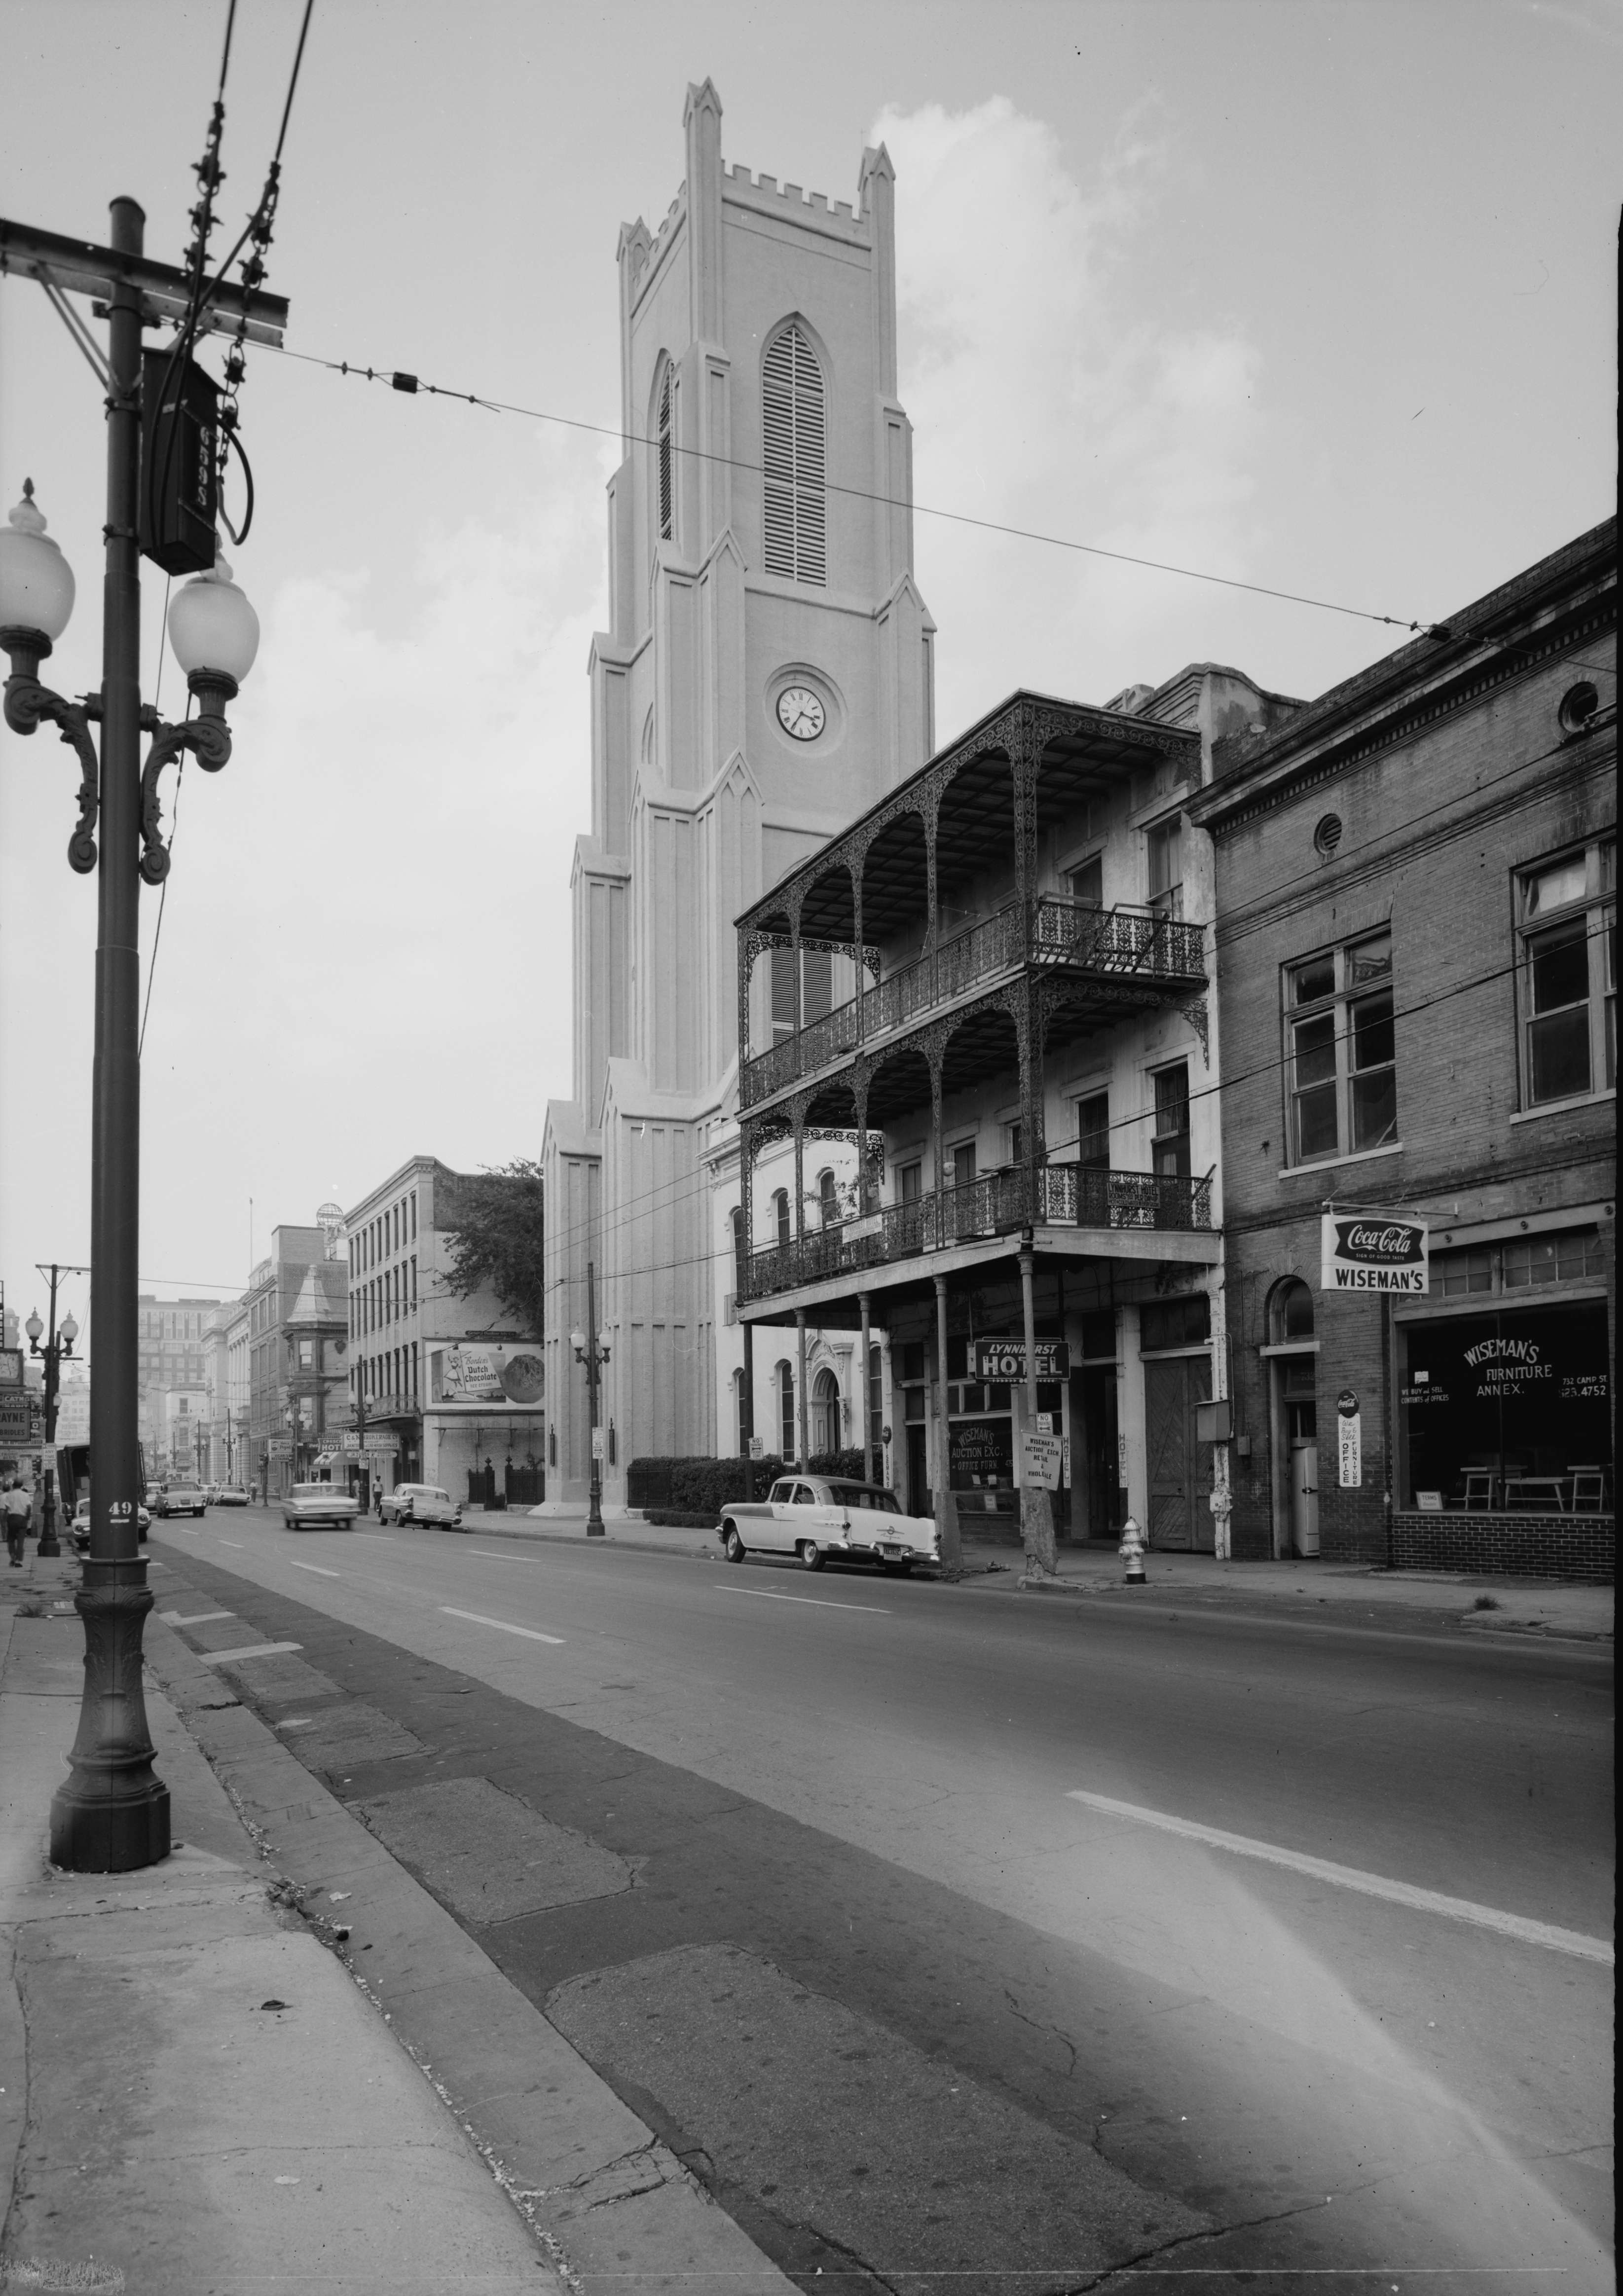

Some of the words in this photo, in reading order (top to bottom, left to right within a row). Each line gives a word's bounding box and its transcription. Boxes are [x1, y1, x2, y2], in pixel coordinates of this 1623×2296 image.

[1108, 1183, 1139, 1194] LYNNHURST
[1141, 1186, 1158, 1196] HOTEL
[1347, 1224, 1413, 1253] Coca-Cola
[1335, 1269, 1423, 1290] WISEMAN'S
[989, 1344, 1058, 1354] LYNNHRST
[1463, 1339, 1540, 1367] WISEMAN'S
[464, 1356, 488, 1365] Borden's
[982, 1356, 1063, 1376] HOTEL
[467, 1366, 488, 1374] Dutch
[1486, 1364, 1553, 1381] FURNITURE
[465, 1374, 497, 1383] Chocolate
[1300, 1372, 1315, 1381] 732
[1476, 1383, 1525, 1397] ANNEX.
[1424, 1395, 1430, 1404] of
[958, 1426, 994, 1448] WISEMAN'S
[1030, 1438, 1055, 1447] WISEMAN'S
[952, 1447, 982, 1458] AUCTION
[984, 1446, 1003, 1458] EXC.
[958, 1461, 979, 1471] OFFICE
[981, 1459, 999, 1470] FURN.
[109, 1501, 132, 1515] 49
